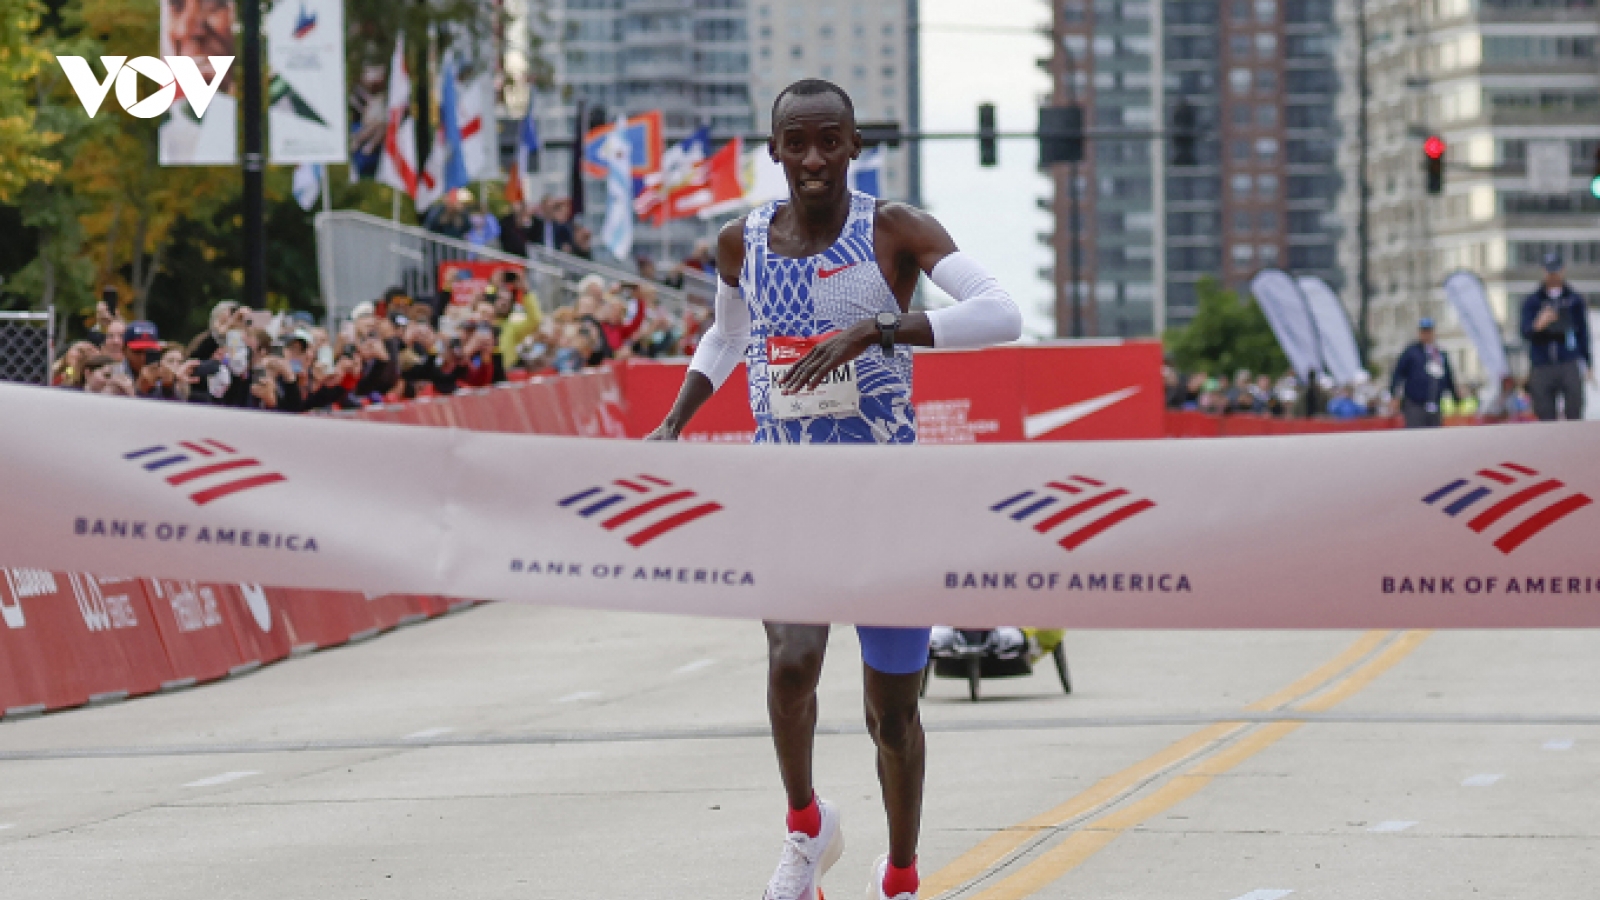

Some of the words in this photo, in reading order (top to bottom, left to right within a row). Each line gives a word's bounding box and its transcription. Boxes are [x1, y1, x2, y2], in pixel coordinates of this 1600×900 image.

[74, 517, 148, 540] BANK
[155, 522, 188, 542] OF
[196, 526, 319, 552] AMERICA
[510, 558, 582, 577] BANK
[591, 563, 624, 580] OF
[632, 566, 755, 586] AMERICA
[944, 571, 1018, 590] BANK
[1026, 571, 1060, 590] OF
[1067, 572, 1192, 593] AMERICA
[1381, 575, 1455, 595] BANK
[1463, 575, 1499, 595] OF
